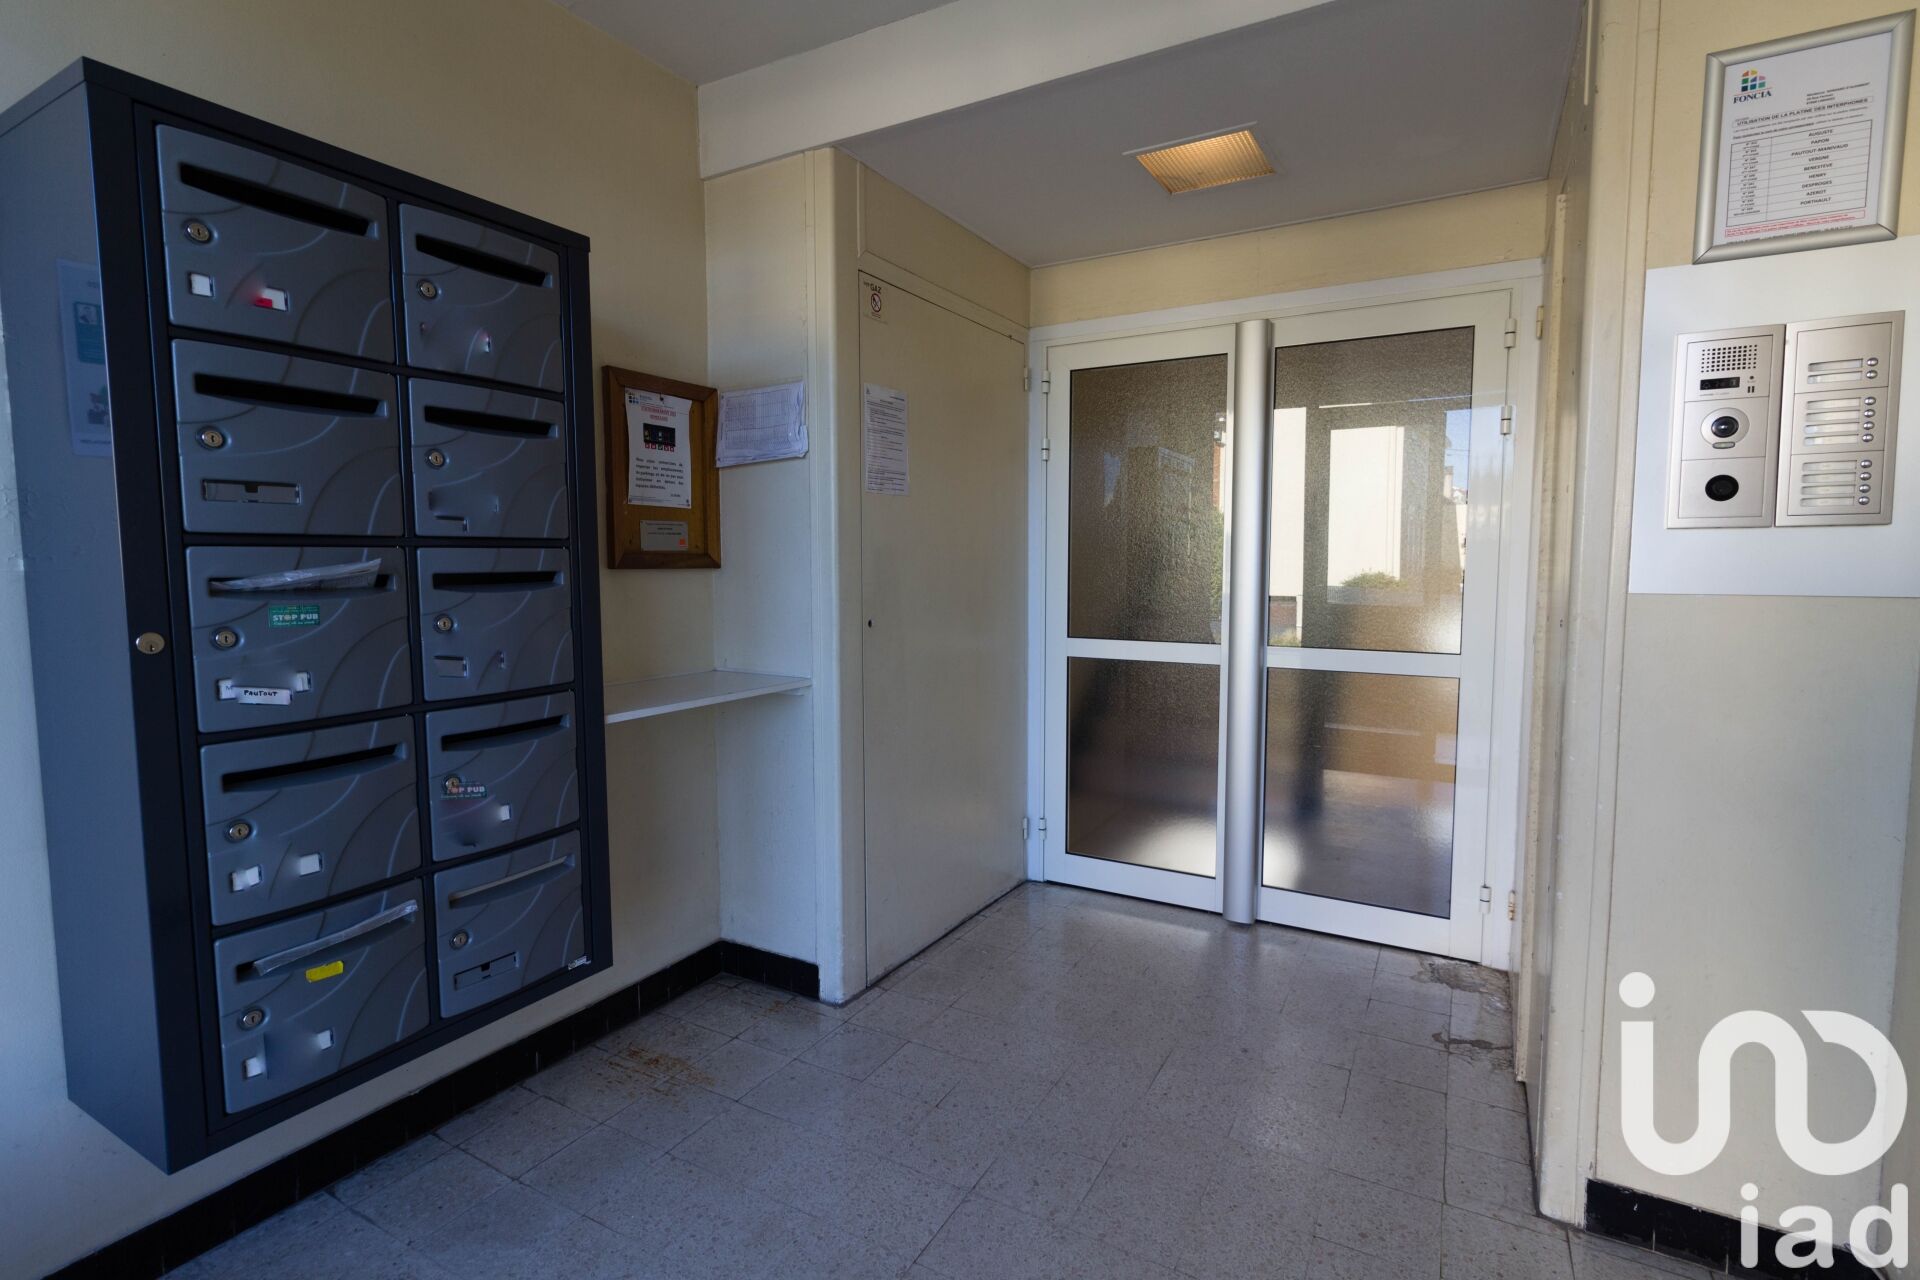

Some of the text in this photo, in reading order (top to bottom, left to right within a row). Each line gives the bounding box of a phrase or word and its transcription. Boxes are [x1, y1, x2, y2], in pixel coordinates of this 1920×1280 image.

[1733, 90, 1772, 104] FONCIA
[1737, 116, 1771, 126] UTILISATION
[1789, 107, 1812, 117] PLATINE
[1827, 98, 1869, 109] INTERPHONES
